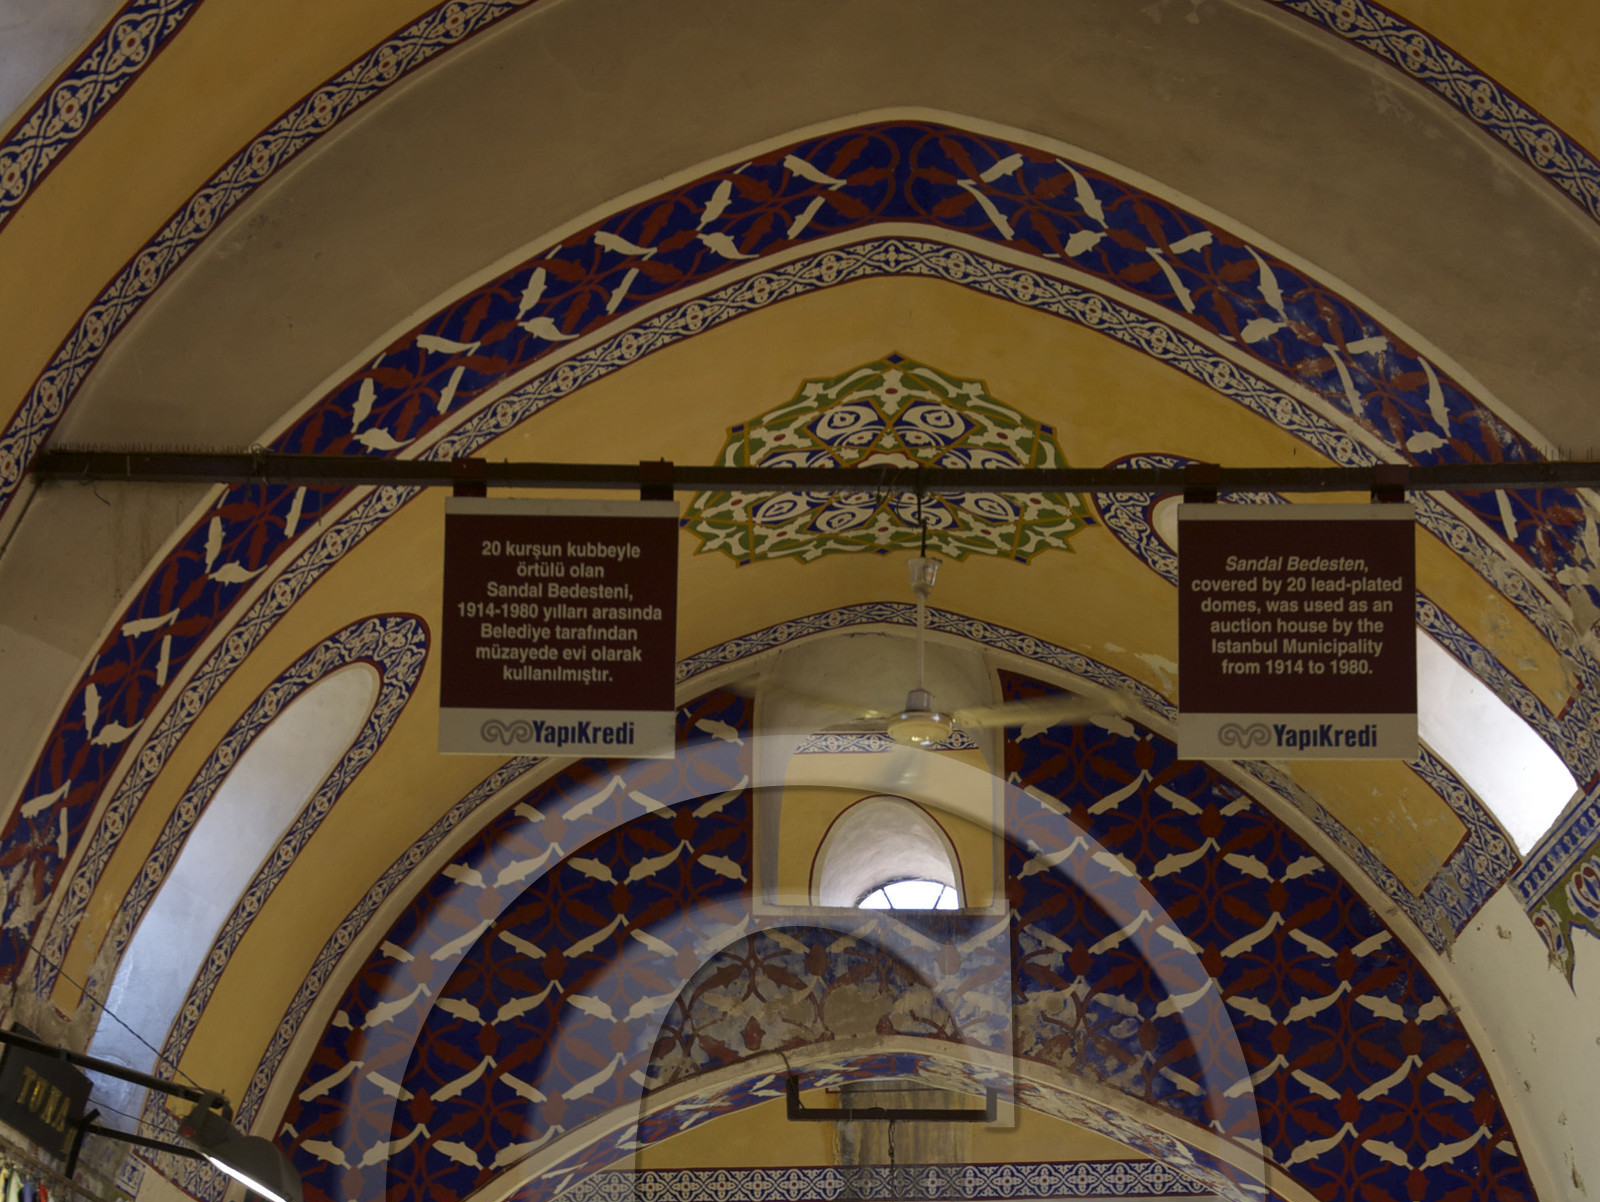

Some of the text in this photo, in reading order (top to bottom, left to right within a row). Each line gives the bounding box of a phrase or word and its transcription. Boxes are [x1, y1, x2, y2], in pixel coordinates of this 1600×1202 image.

[482, 541, 641, 562] 20 kurşun kubbeyle
[517, 562, 604, 578] örtülü olan
[1225, 556, 1368, 573] Sandal Bedesten,
[487, 582, 633, 601] Sandal Bedesteni,
[1192, 577, 1403, 595] covered by 20 lead-plated
[458, 602, 662, 622] 1914-1980 yılları arasında
[1201, 598, 1393, 615] domes, was used as an
[481, 623, 638, 642] Belediye tarafından
[1211, 619, 1384, 636] auction house by the
[476, 644, 642, 663] müzayede evi olarak
[1212, 639, 1382, 657] Istanbul Municipality
[503, 666, 613, 685] kullanılmıştır.
[1222, 659, 1373, 674] from 1914 to 1980.
[532, 720, 634, 747] YapıKredi
[1273, 724, 1377, 751] YapıKredi
